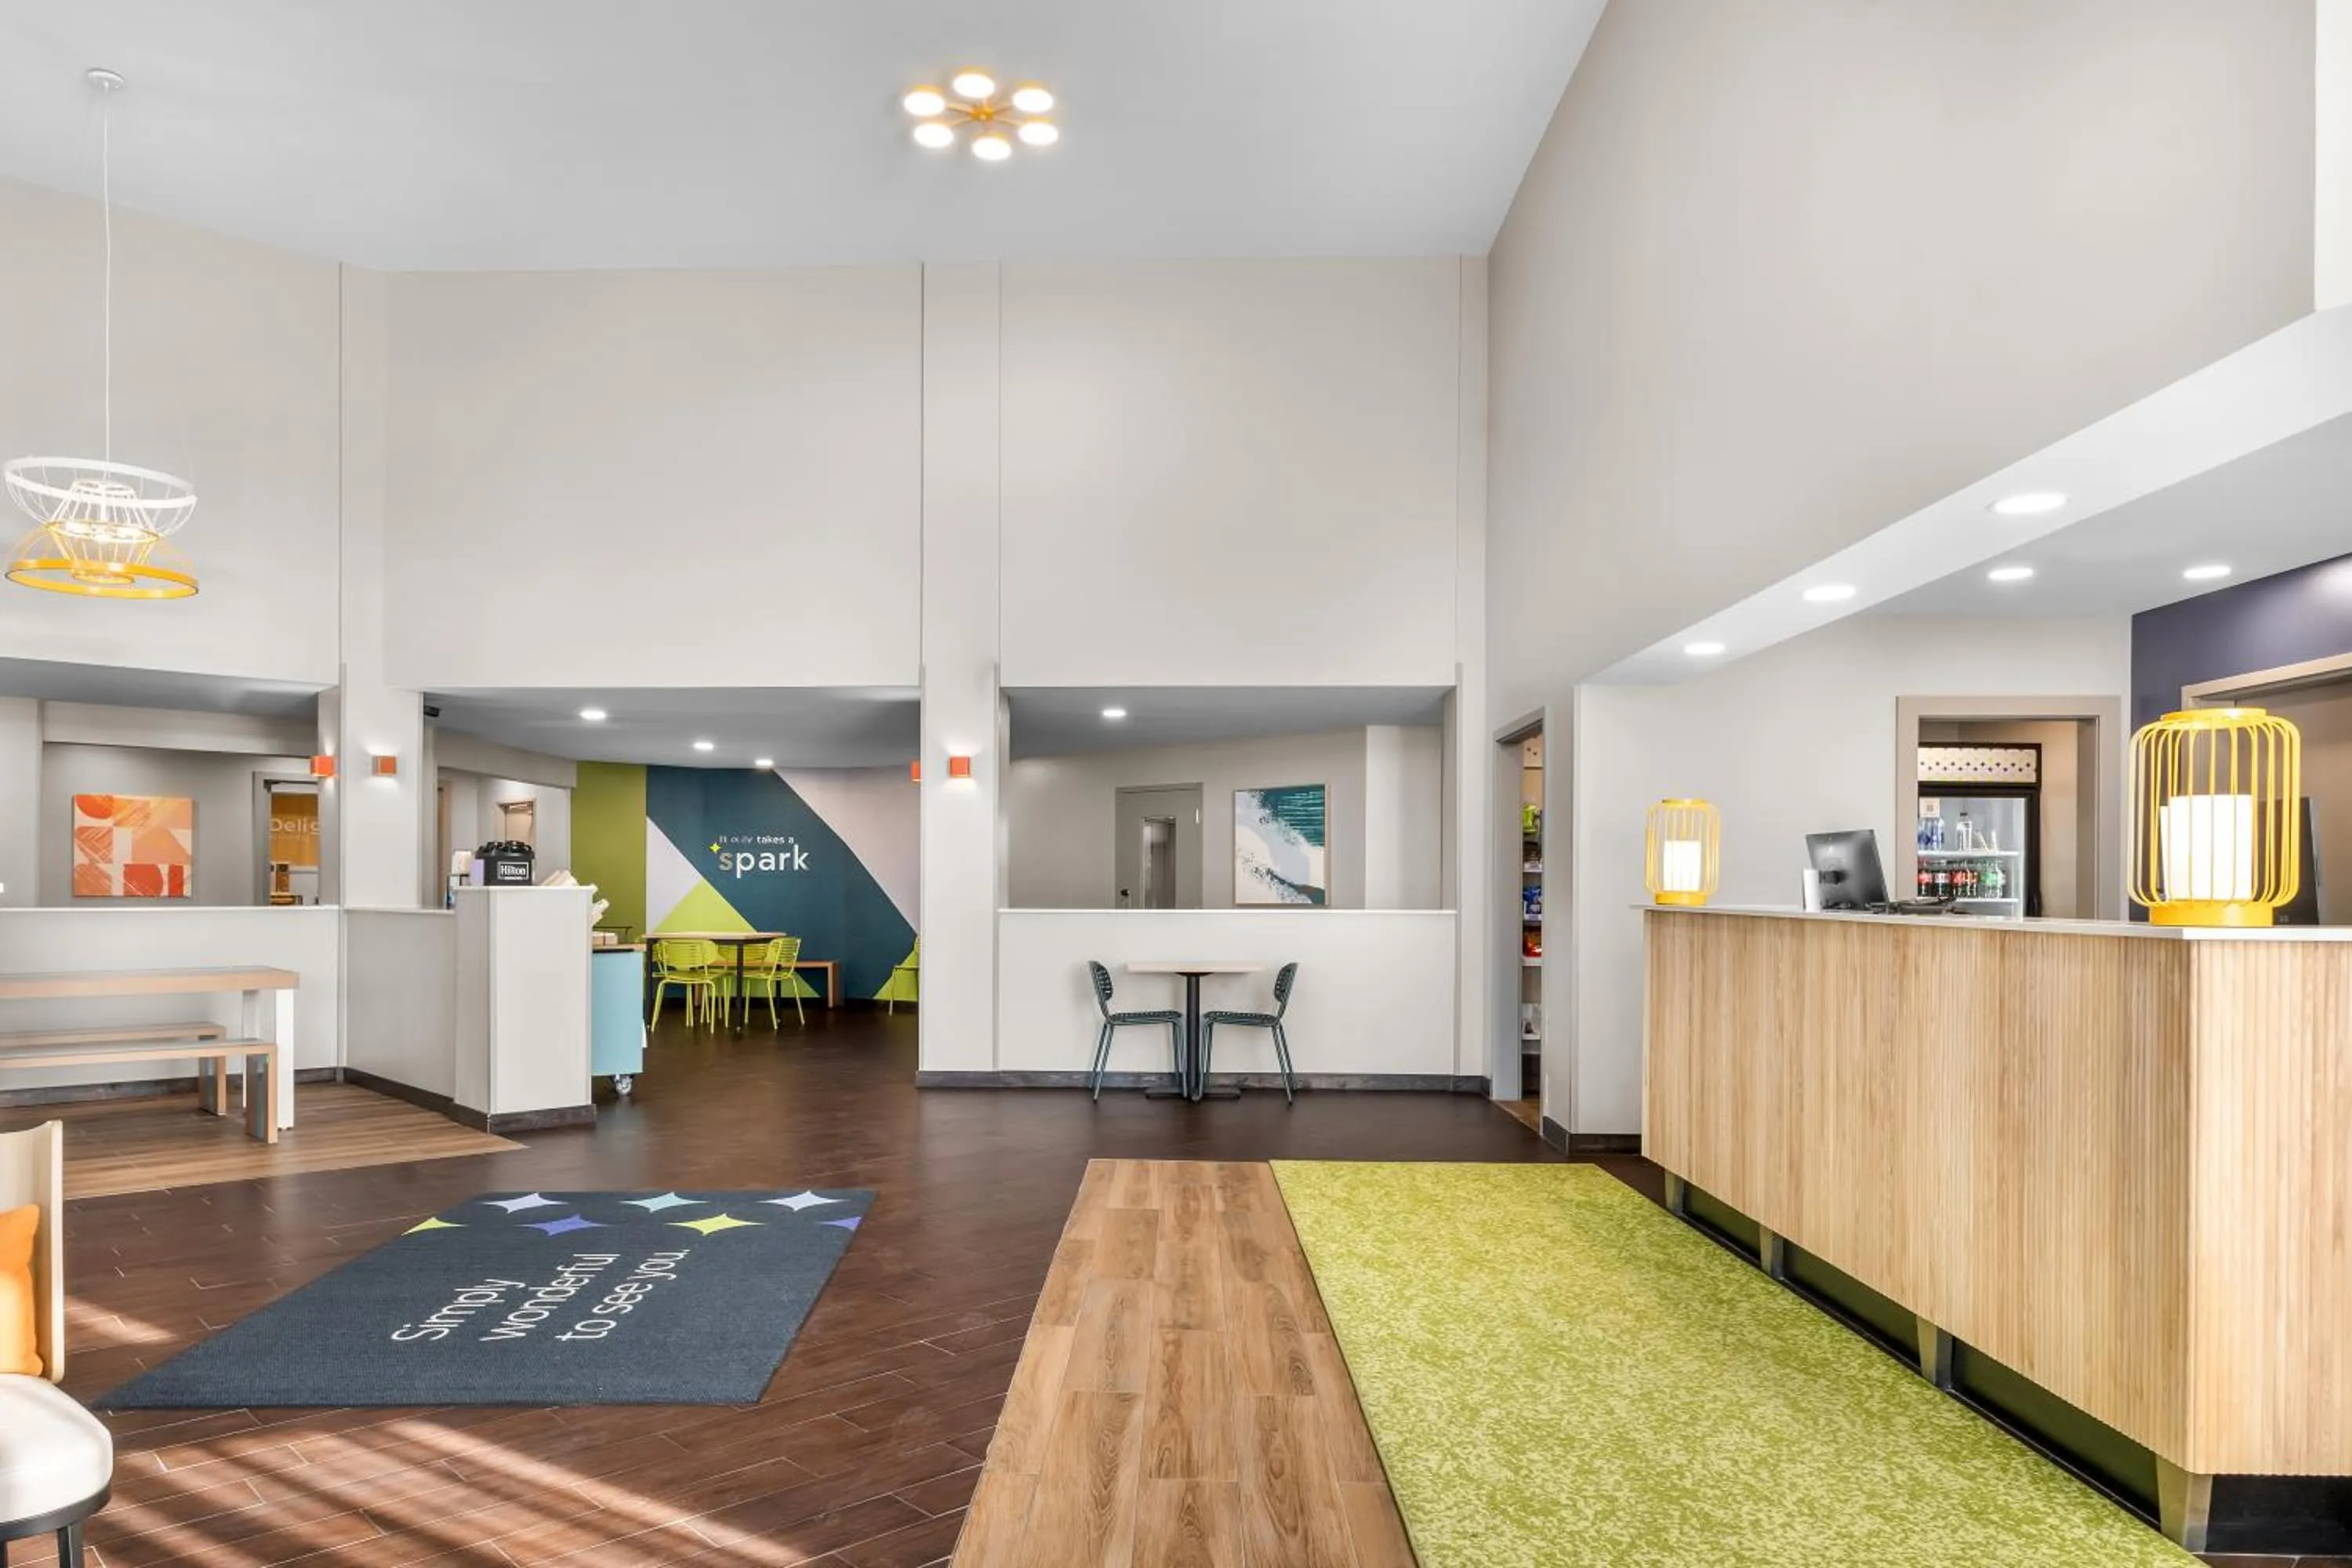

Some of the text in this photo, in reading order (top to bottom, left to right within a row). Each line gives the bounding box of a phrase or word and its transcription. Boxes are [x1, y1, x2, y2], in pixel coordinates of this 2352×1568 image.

[718, 844, 810, 879] spark
[757, 835, 785, 844] takes
[501, 865, 526, 876] Hilton
[391, 1279, 526, 1341] Simply
[480, 1253, 622, 1341] wonderful
[555, 1249, 691, 1341] to see you.
